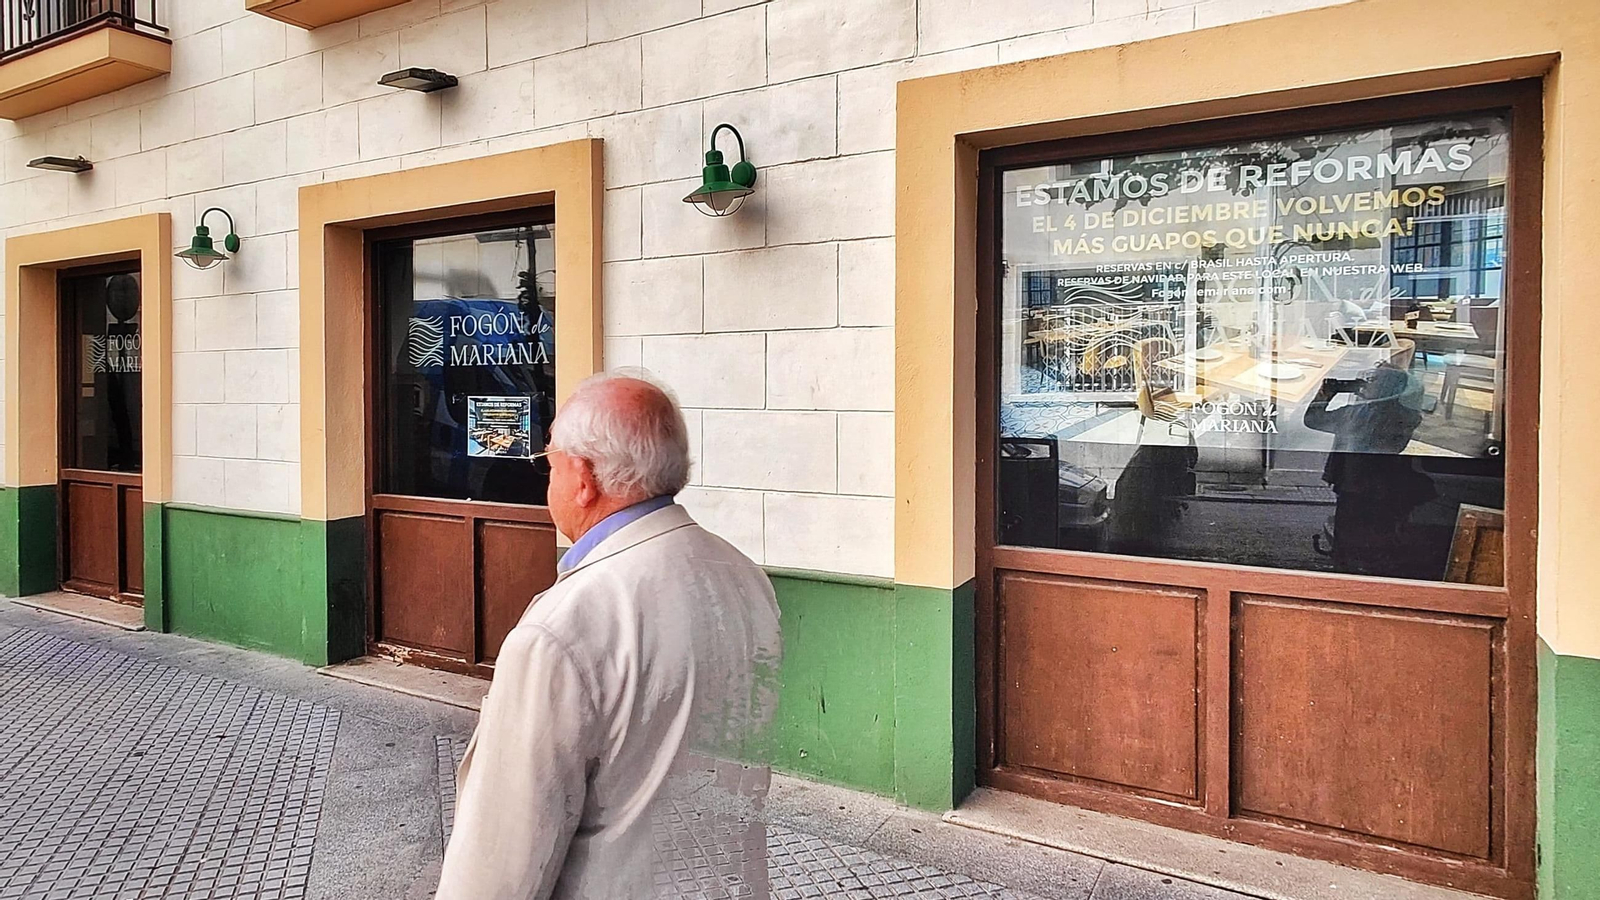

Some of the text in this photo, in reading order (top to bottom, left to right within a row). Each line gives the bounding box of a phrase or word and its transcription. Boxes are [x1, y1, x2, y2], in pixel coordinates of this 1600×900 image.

[1016, 144, 1473, 207] ESTAMOS DE REFORMAS
[1032, 185, 1446, 233] EL 4 DE DICIEMBRE VOLVEMOS
[1053, 217, 1414, 256] MÁS GUAPOS QUE NUNCA!
[1057, 276, 1112, 288] RESERVAS
[1114, 274, 1129, 285] DE
[1189, 271, 1219, 281] PARA
[1222, 269, 1252, 280] ESTE
[1256, 267, 1294, 279] LOCAL
[1301, 267, 1318, 277] EN
[1322, 263, 1386, 276] NUESTRA
[1390, 262, 1428, 273] WEB.
[1096, 252, 1354, 274] RESERVAS EN c/ BRASIL HASTA APERTURA.
[450, 306, 551, 337] FOGÓN de
[450, 341, 550, 367] MARIANA
[1191, 419, 1278, 434] MARIANA
